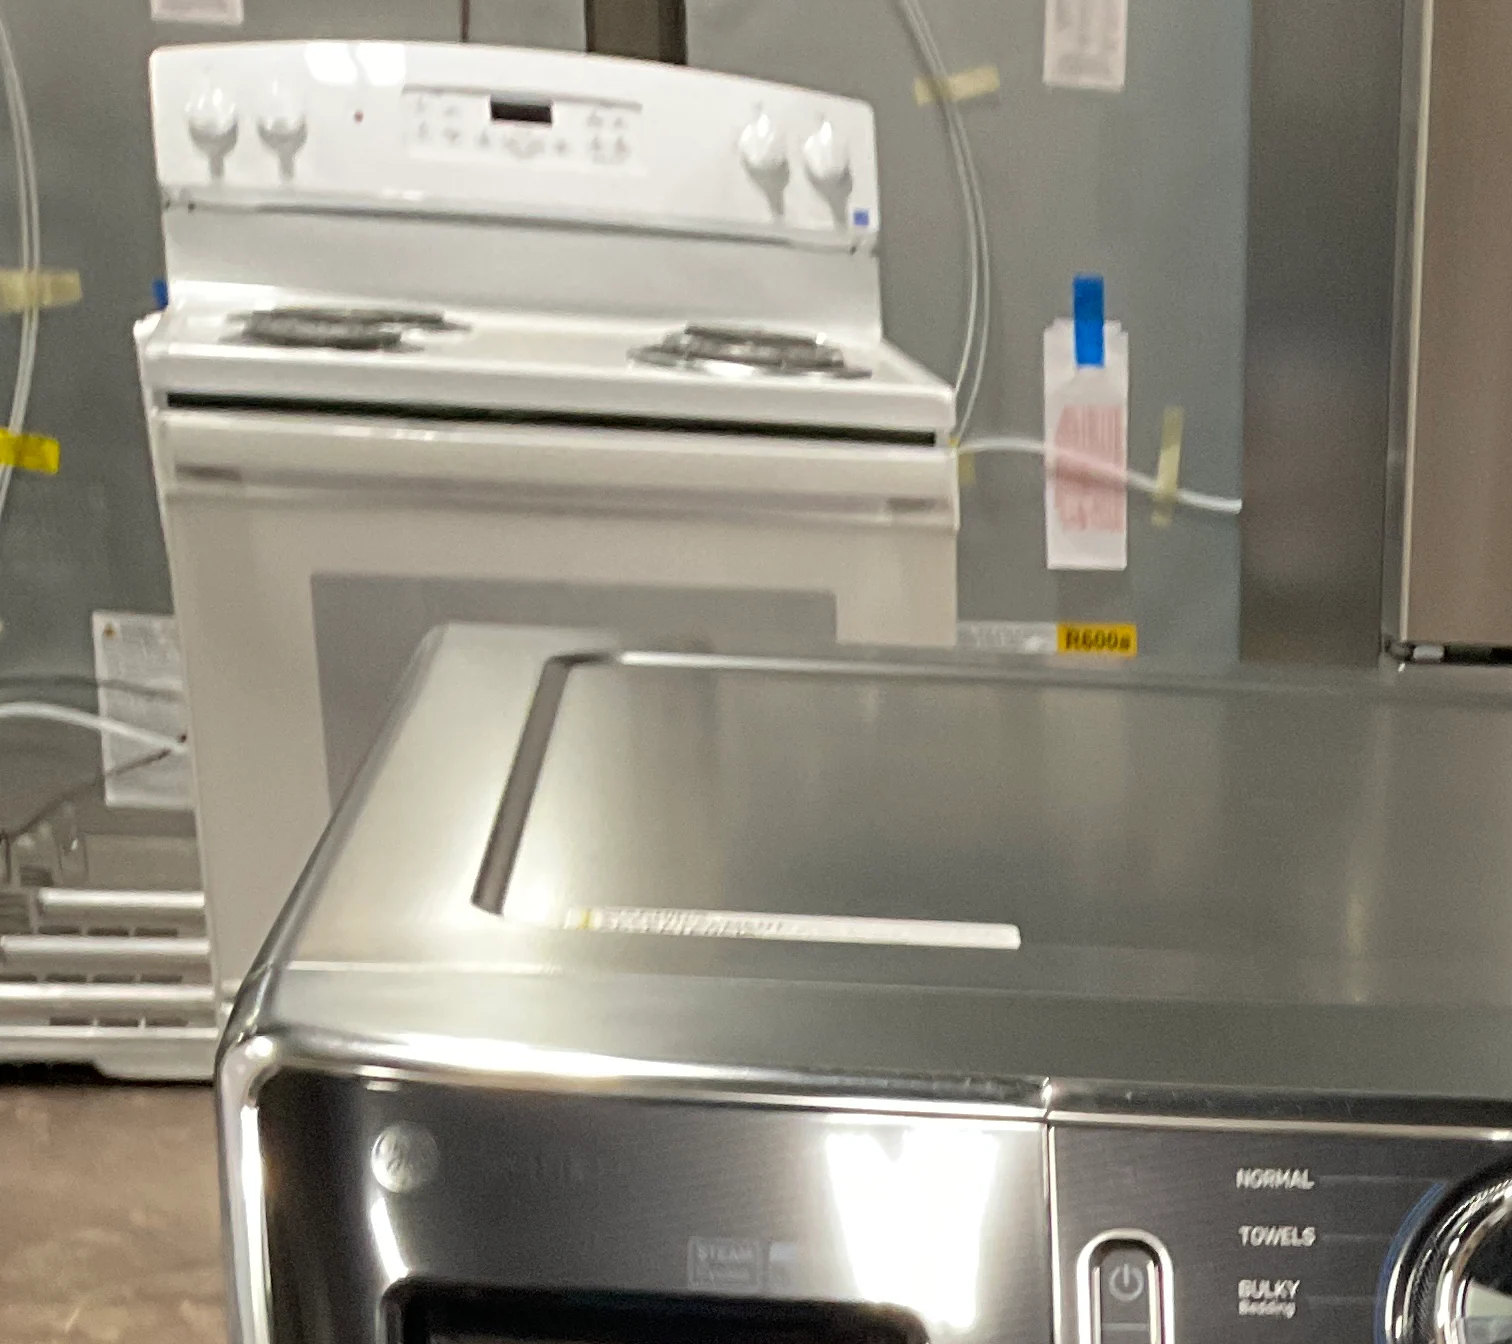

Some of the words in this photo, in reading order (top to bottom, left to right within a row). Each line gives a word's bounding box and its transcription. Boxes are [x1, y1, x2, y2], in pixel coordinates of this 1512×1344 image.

[1236, 1169, 1315, 1190] NORMAL
[1238, 1225, 1316, 1247] TOWELS
[1237, 1279, 1300, 1300] BULKY
